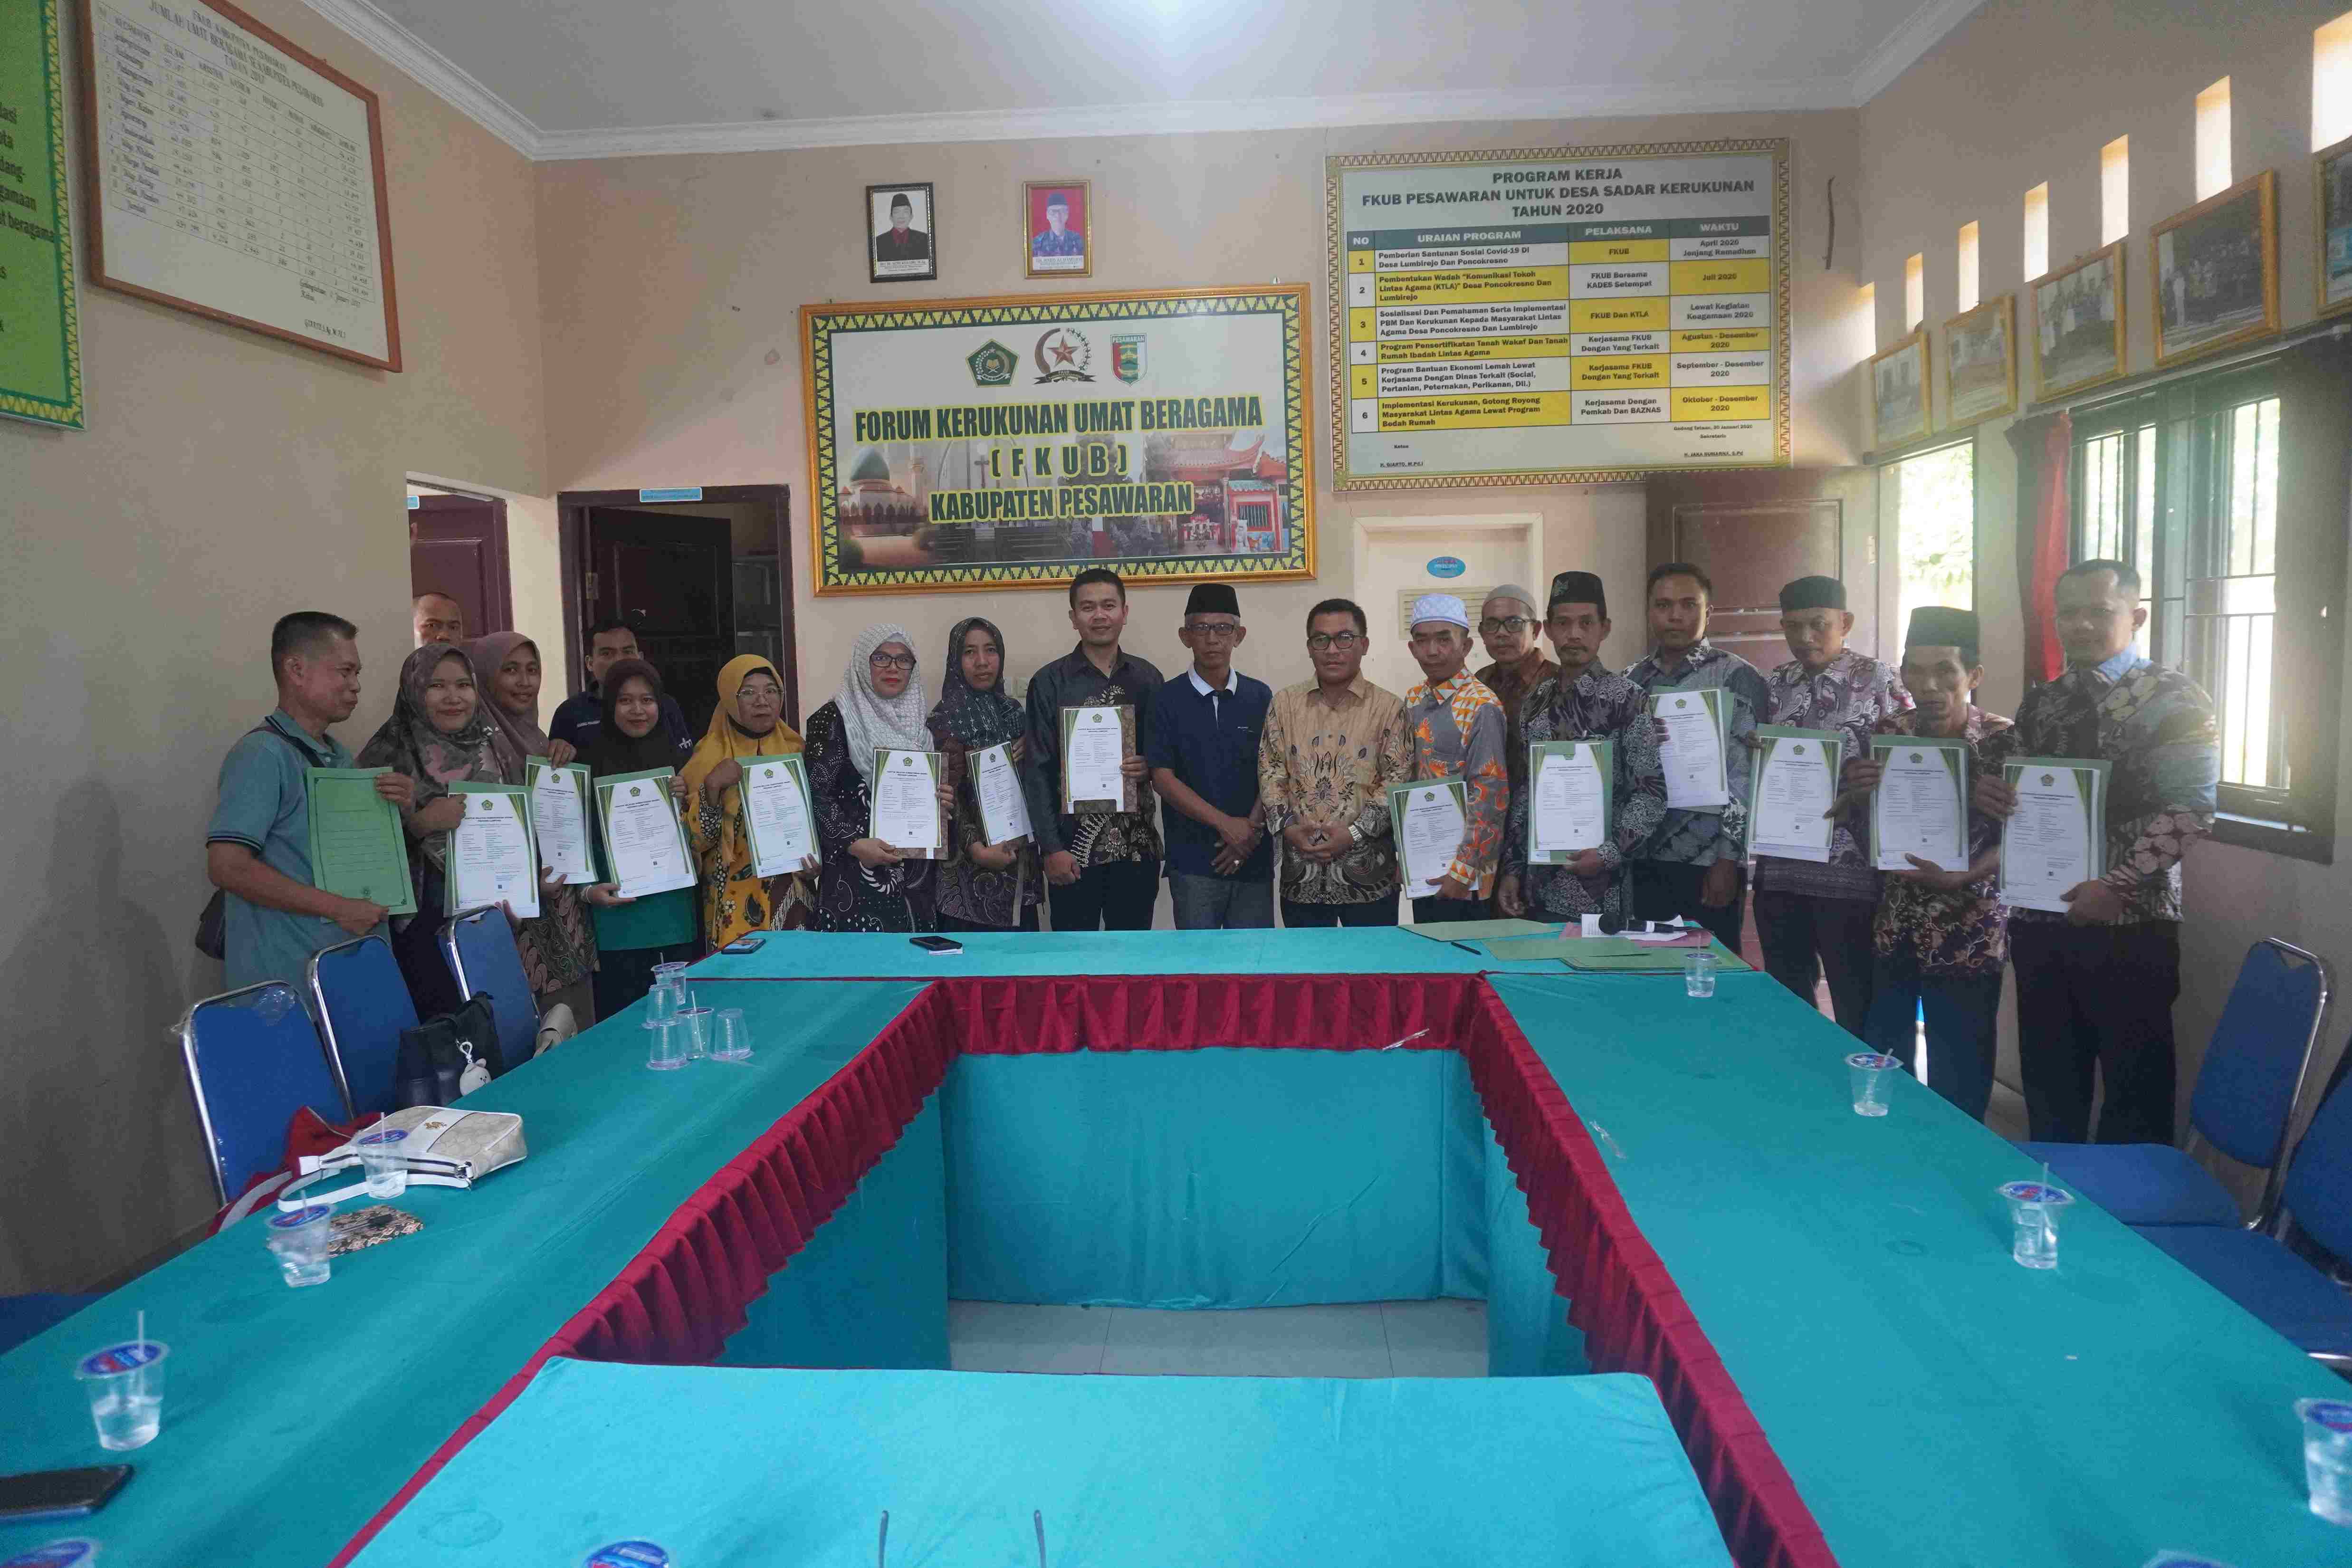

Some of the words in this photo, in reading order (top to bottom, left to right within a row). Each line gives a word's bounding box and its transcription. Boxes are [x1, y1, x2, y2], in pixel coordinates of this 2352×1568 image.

[1493, 170, 1570, 184] PROGRAM
[1575, 168, 1622, 181] KERJA
[1362, 193, 1402, 206] FKUB
[1406, 190, 1501, 204] PESAWARAN
[1505, 188, 1555, 200] UNTUK
[1559, 186, 1599, 198] DESA
[1604, 183, 1655, 196] SADAR
[1660, 180, 1753, 194] KERUKUNAN
[1512, 204, 1561, 217] TAHUN
[1566, 202, 1604, 215] 2020
[1585, 225, 1652, 236] PELAKSANA
[1699, 222, 1739, 231] WAKTU
[1353, 237, 1369, 245] NO
[1417, 233, 1460, 242] URAIAN
[1463, 231, 1520, 240] PROGRAM
[1700, 239, 1718, 248] April
[1378, 251, 1420, 259] Pemberian
[1683, 249, 1713, 258] Jenjang
[1400, 259, 1438, 268] Lumbirejo
[1457, 257, 1508, 265] Poncokresno
[1379, 275, 1432, 283] Pembentukan
[1405, 284, 1432, 292] Agama
[1484, 280, 1534, 288] Poncokresno
[1615, 280, 1652, 288] Setempat
[1379, 293, 1418, 302] Lumbirejo
[1513, 304, 1566, 313] Implementasi
[1715, 302, 1750, 310] Kegiatan
[1460, 316, 1489, 324] Kepada
[1491, 315, 1536, 323] Masyarakat
[1687, 312, 1732, 321] Keagamaan
[1380, 328, 1406, 337] Agama
[1499, 323, 1538, 332] Lumbirejo
[1112, 335, 1145, 343] PESAWARAN
[1588, 335, 1629, 344] Kerjasama
[1682, 333, 1713, 341] Agustus
[1380, 343, 1413, 352] Program
[1581, 344, 1610, 353] Dengan
[1612, 344, 1631, 352] Yang
[1463, 349, 1490, 357] Agama
[1589, 363, 1629, 372] Kerjasama
[1676, 361, 1718, 370] September
[1381, 367, 1414, 375] Program
[1382, 375, 1422, 384] Kerjasama
[1424, 374, 1453, 382] Dengan
[1581, 373, 1611, 382] Dengan
[1613, 372, 1632, 381] Yang
[1382, 401, 1434, 410] Implementasi
[1482, 398, 1510, 406] Gotong
[1511, 396, 1540, 405] Royong
[1585, 398, 1625, 407] Kerjasama
[1627, 397, 1656, 406] Dengan
[1382, 410, 1427, 419] Masyarakat
[1454, 408, 1481, 416] Agama
[1508, 406, 1540, 414] Program
[856, 410, 931, 441] FORUM
[937, 403, 1068, 438] KERUKUNAN
[1074, 401, 1135, 432] UMAT
[1140, 396, 1262, 430] BERAGAMA
[931, 489, 1053, 521] KABUPATEN
[1060, 484, 1192, 516] PESAWARAN
